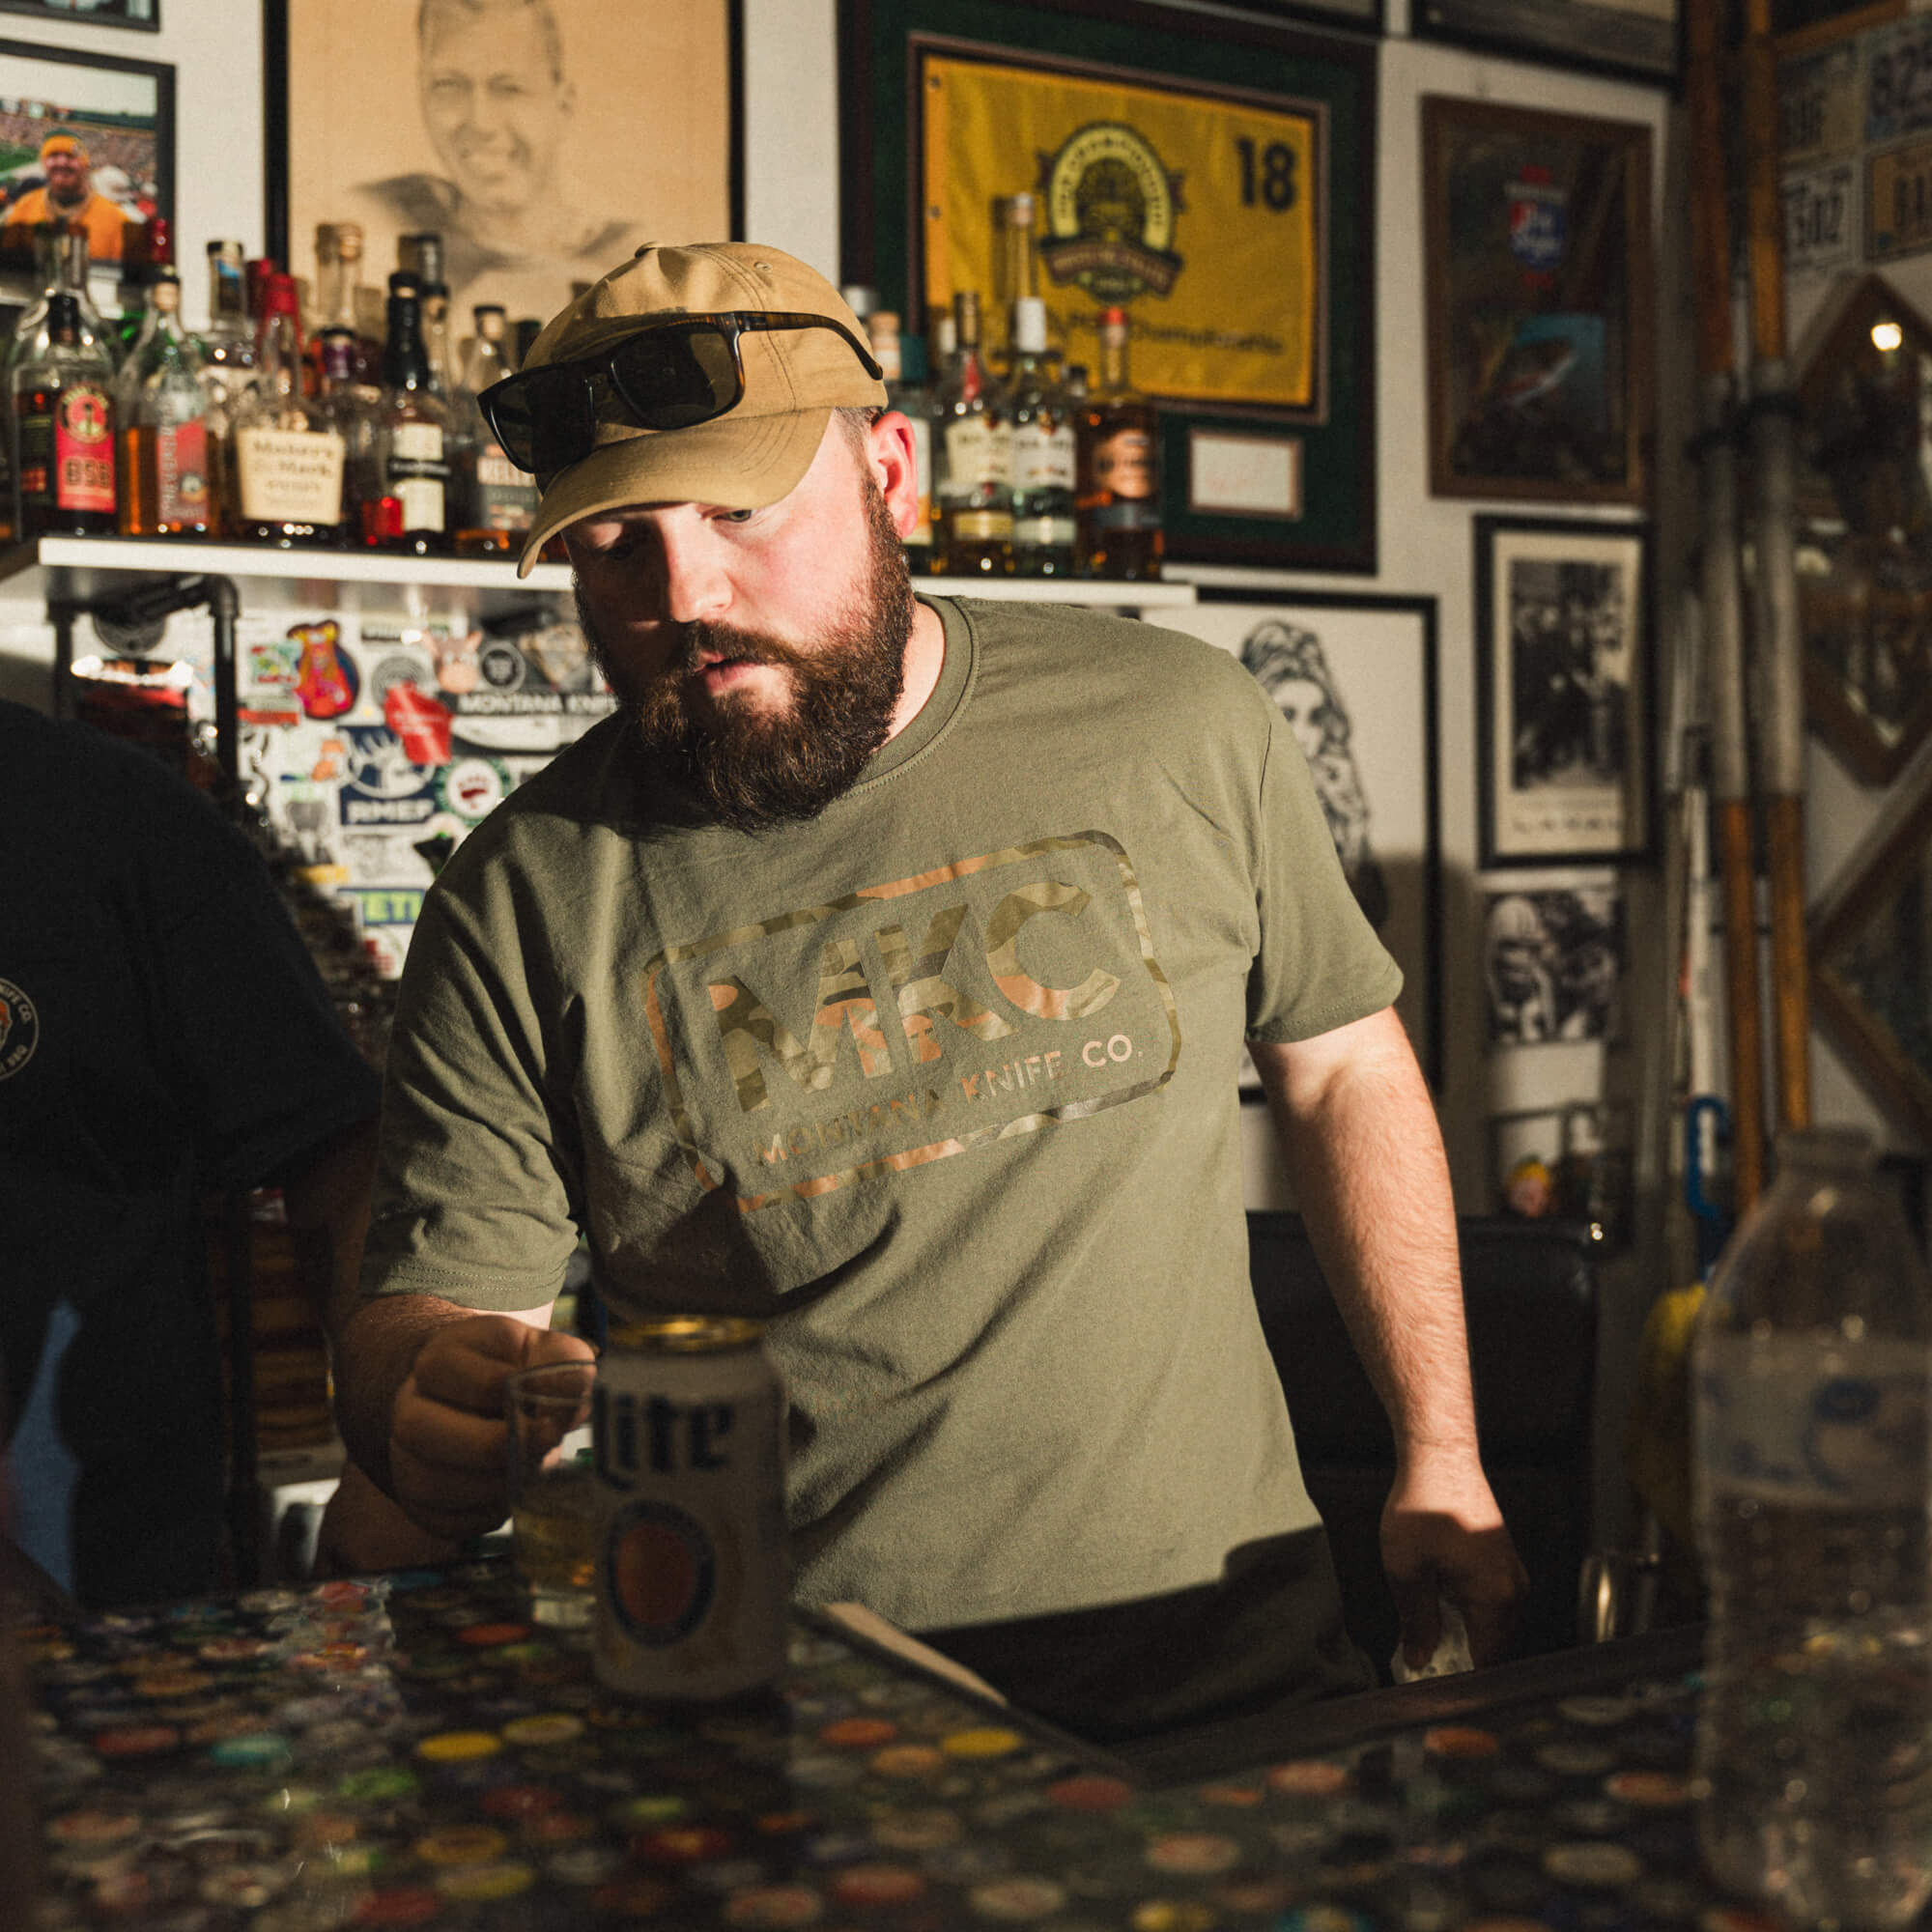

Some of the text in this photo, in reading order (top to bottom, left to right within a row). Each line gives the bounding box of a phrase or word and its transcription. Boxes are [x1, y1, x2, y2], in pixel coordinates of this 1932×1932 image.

[1235, 137, 1299, 213] 18
[708, 881, 1122, 1114] MKC
[753, 1034, 1144, 1164] MONTANA KNIFE CO.
